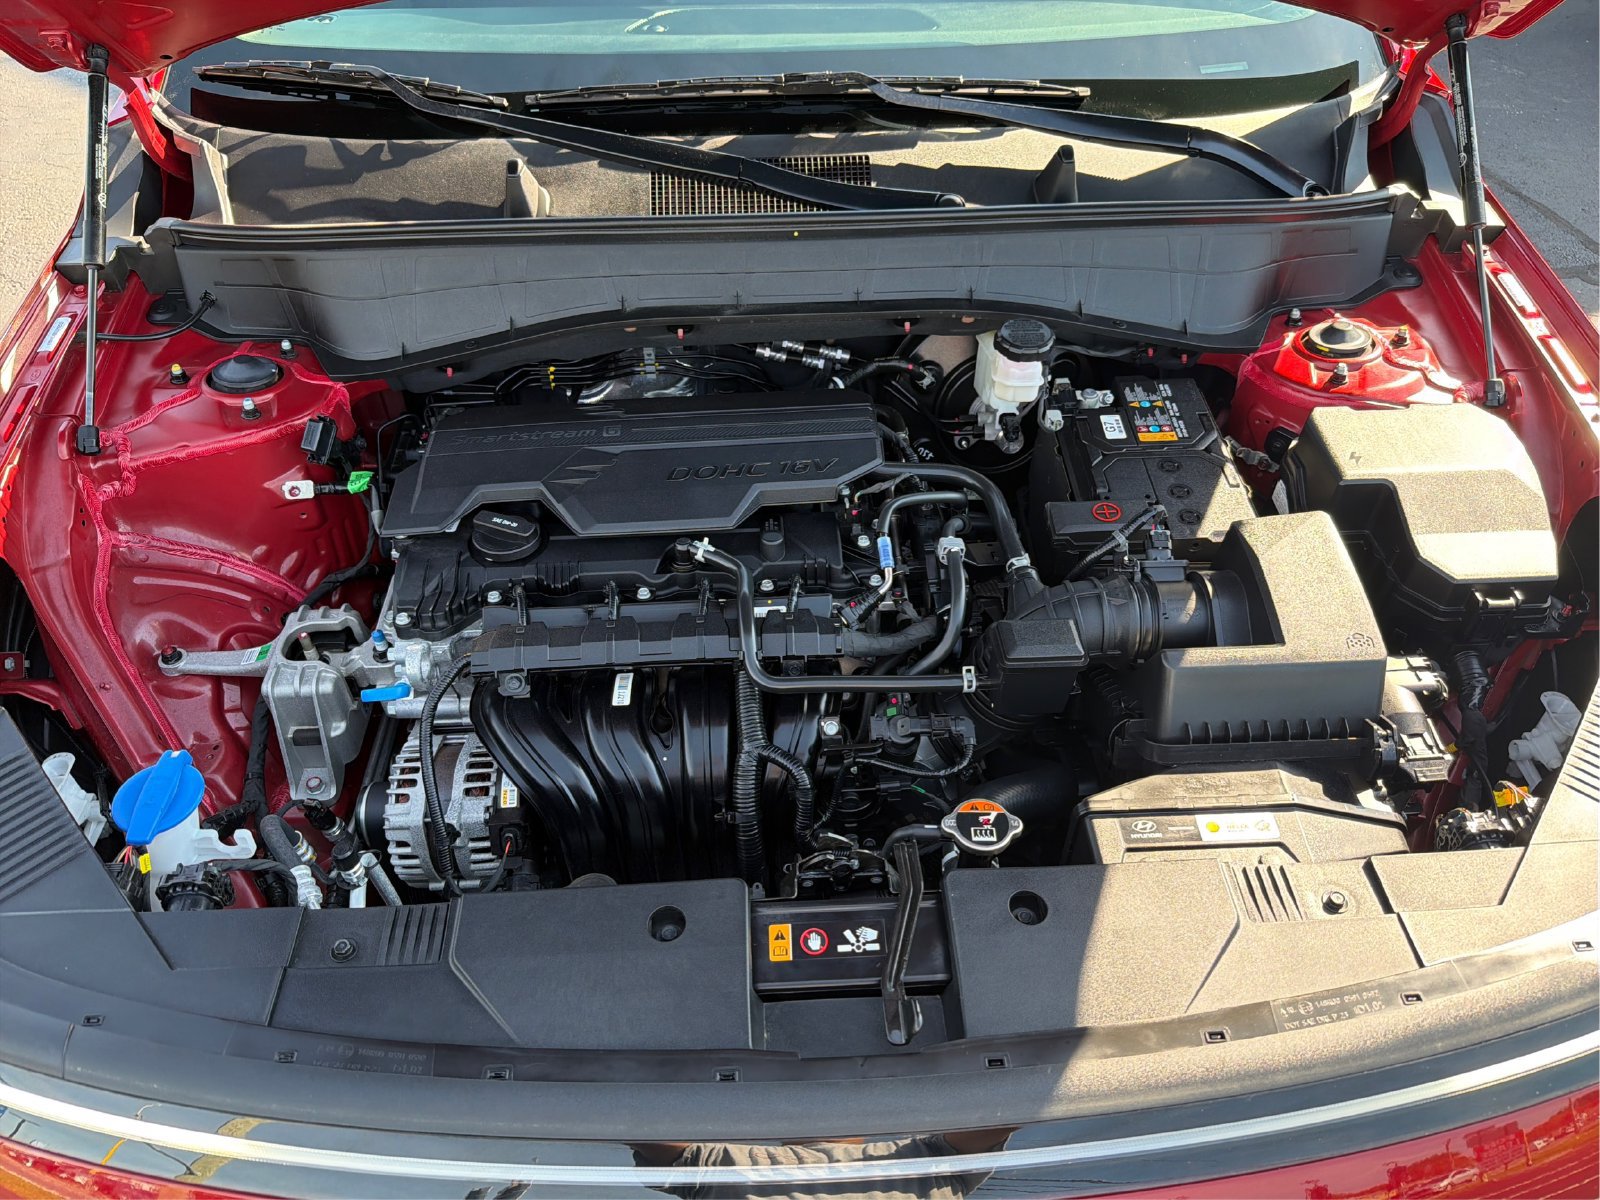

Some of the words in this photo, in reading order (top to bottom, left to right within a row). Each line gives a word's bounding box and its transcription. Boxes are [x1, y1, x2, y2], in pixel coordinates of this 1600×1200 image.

[1104, 421, 1116, 432] G7
[452, 429, 597, 445] Smartstream
[666, 461, 772, 482] DOHC
[780, 457, 839, 476] 16V
